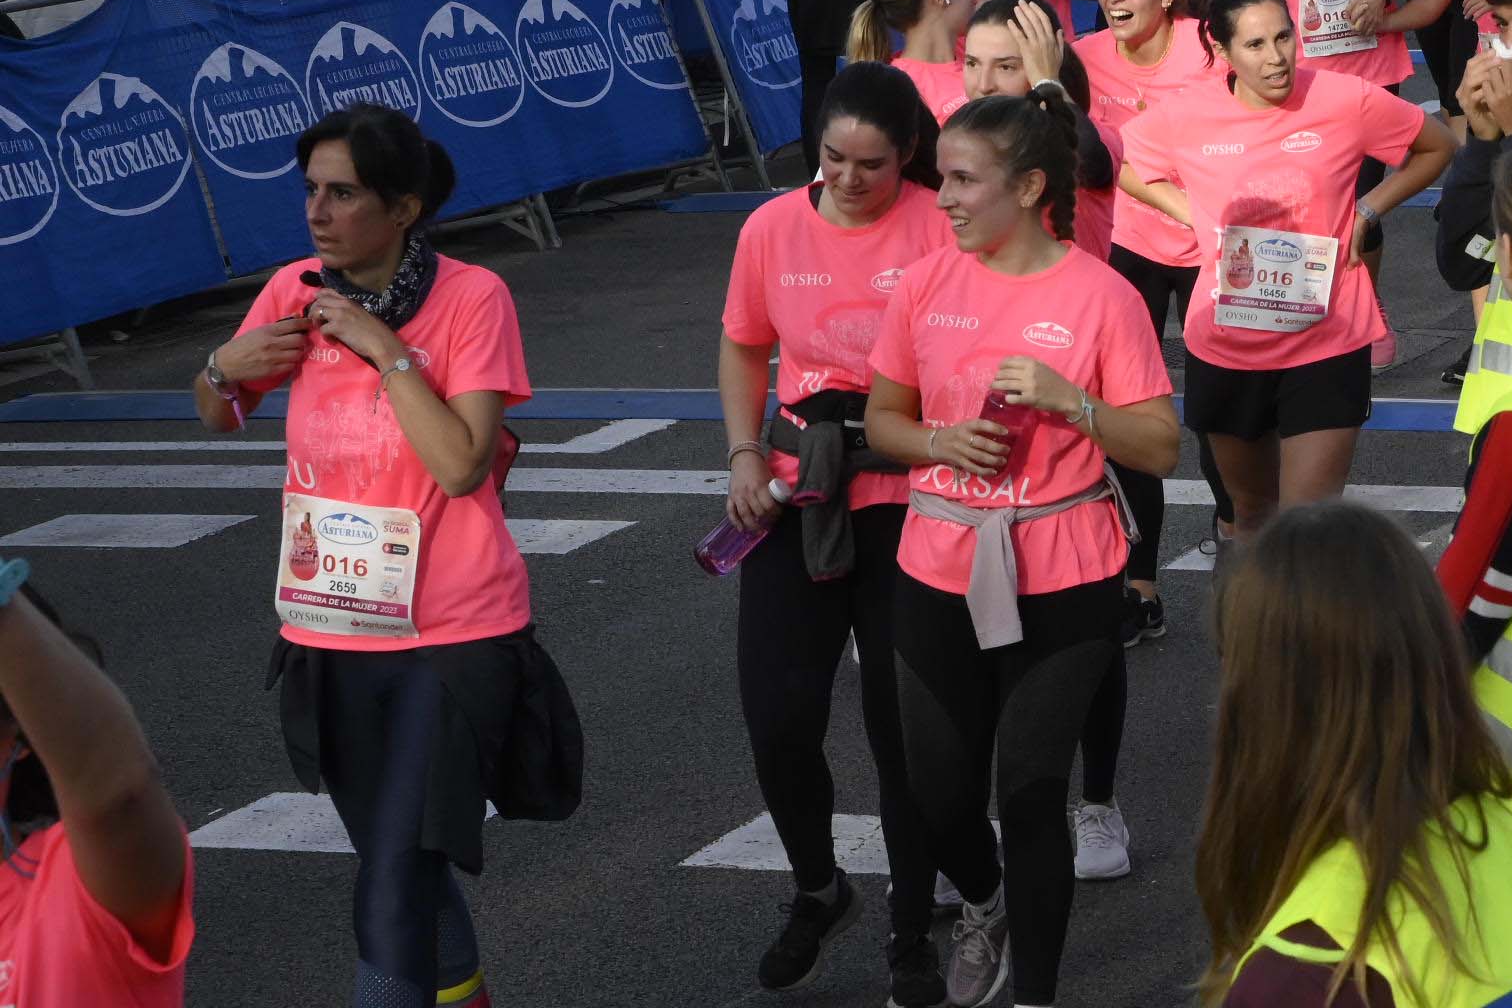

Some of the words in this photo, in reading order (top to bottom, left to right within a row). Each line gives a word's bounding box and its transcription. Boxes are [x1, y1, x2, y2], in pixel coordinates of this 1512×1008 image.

[525, 37, 609, 81] ASTURIANA
[429, 53, 520, 100] ASTURIANA
[203, 99, 305, 152] ASTURIANA
[1203, 143, 1244, 155] OYSHO
[1256, 245, 1300, 260] ASTURIANA
[781, 273, 832, 286] OYSHO
[1257, 269, 1293, 285] 016
[1259, 288, 1286, 298] 16456
[1230, 298, 1259, 307] CARRERA
[927, 313, 979, 330] OYSHO
[1225, 311, 1258, 322] OYSHO
[1027, 331, 1070, 345] ASTURIANA
[321, 523, 373, 540] ASTURIANA
[384, 525, 410, 535] SUMA
[322, 554, 368, 577] 016
[329, 580, 357, 594] 2659
[292, 592, 327, 606] CARRERA
[328, 598, 340, 607] DE
[341, 599, 350, 608] LA
[351, 601, 378, 612] MUJER
[379, 605, 397, 614] 2023
[288, 610, 328, 624] OYSHO
[360, 620, 402, 631] Santander
